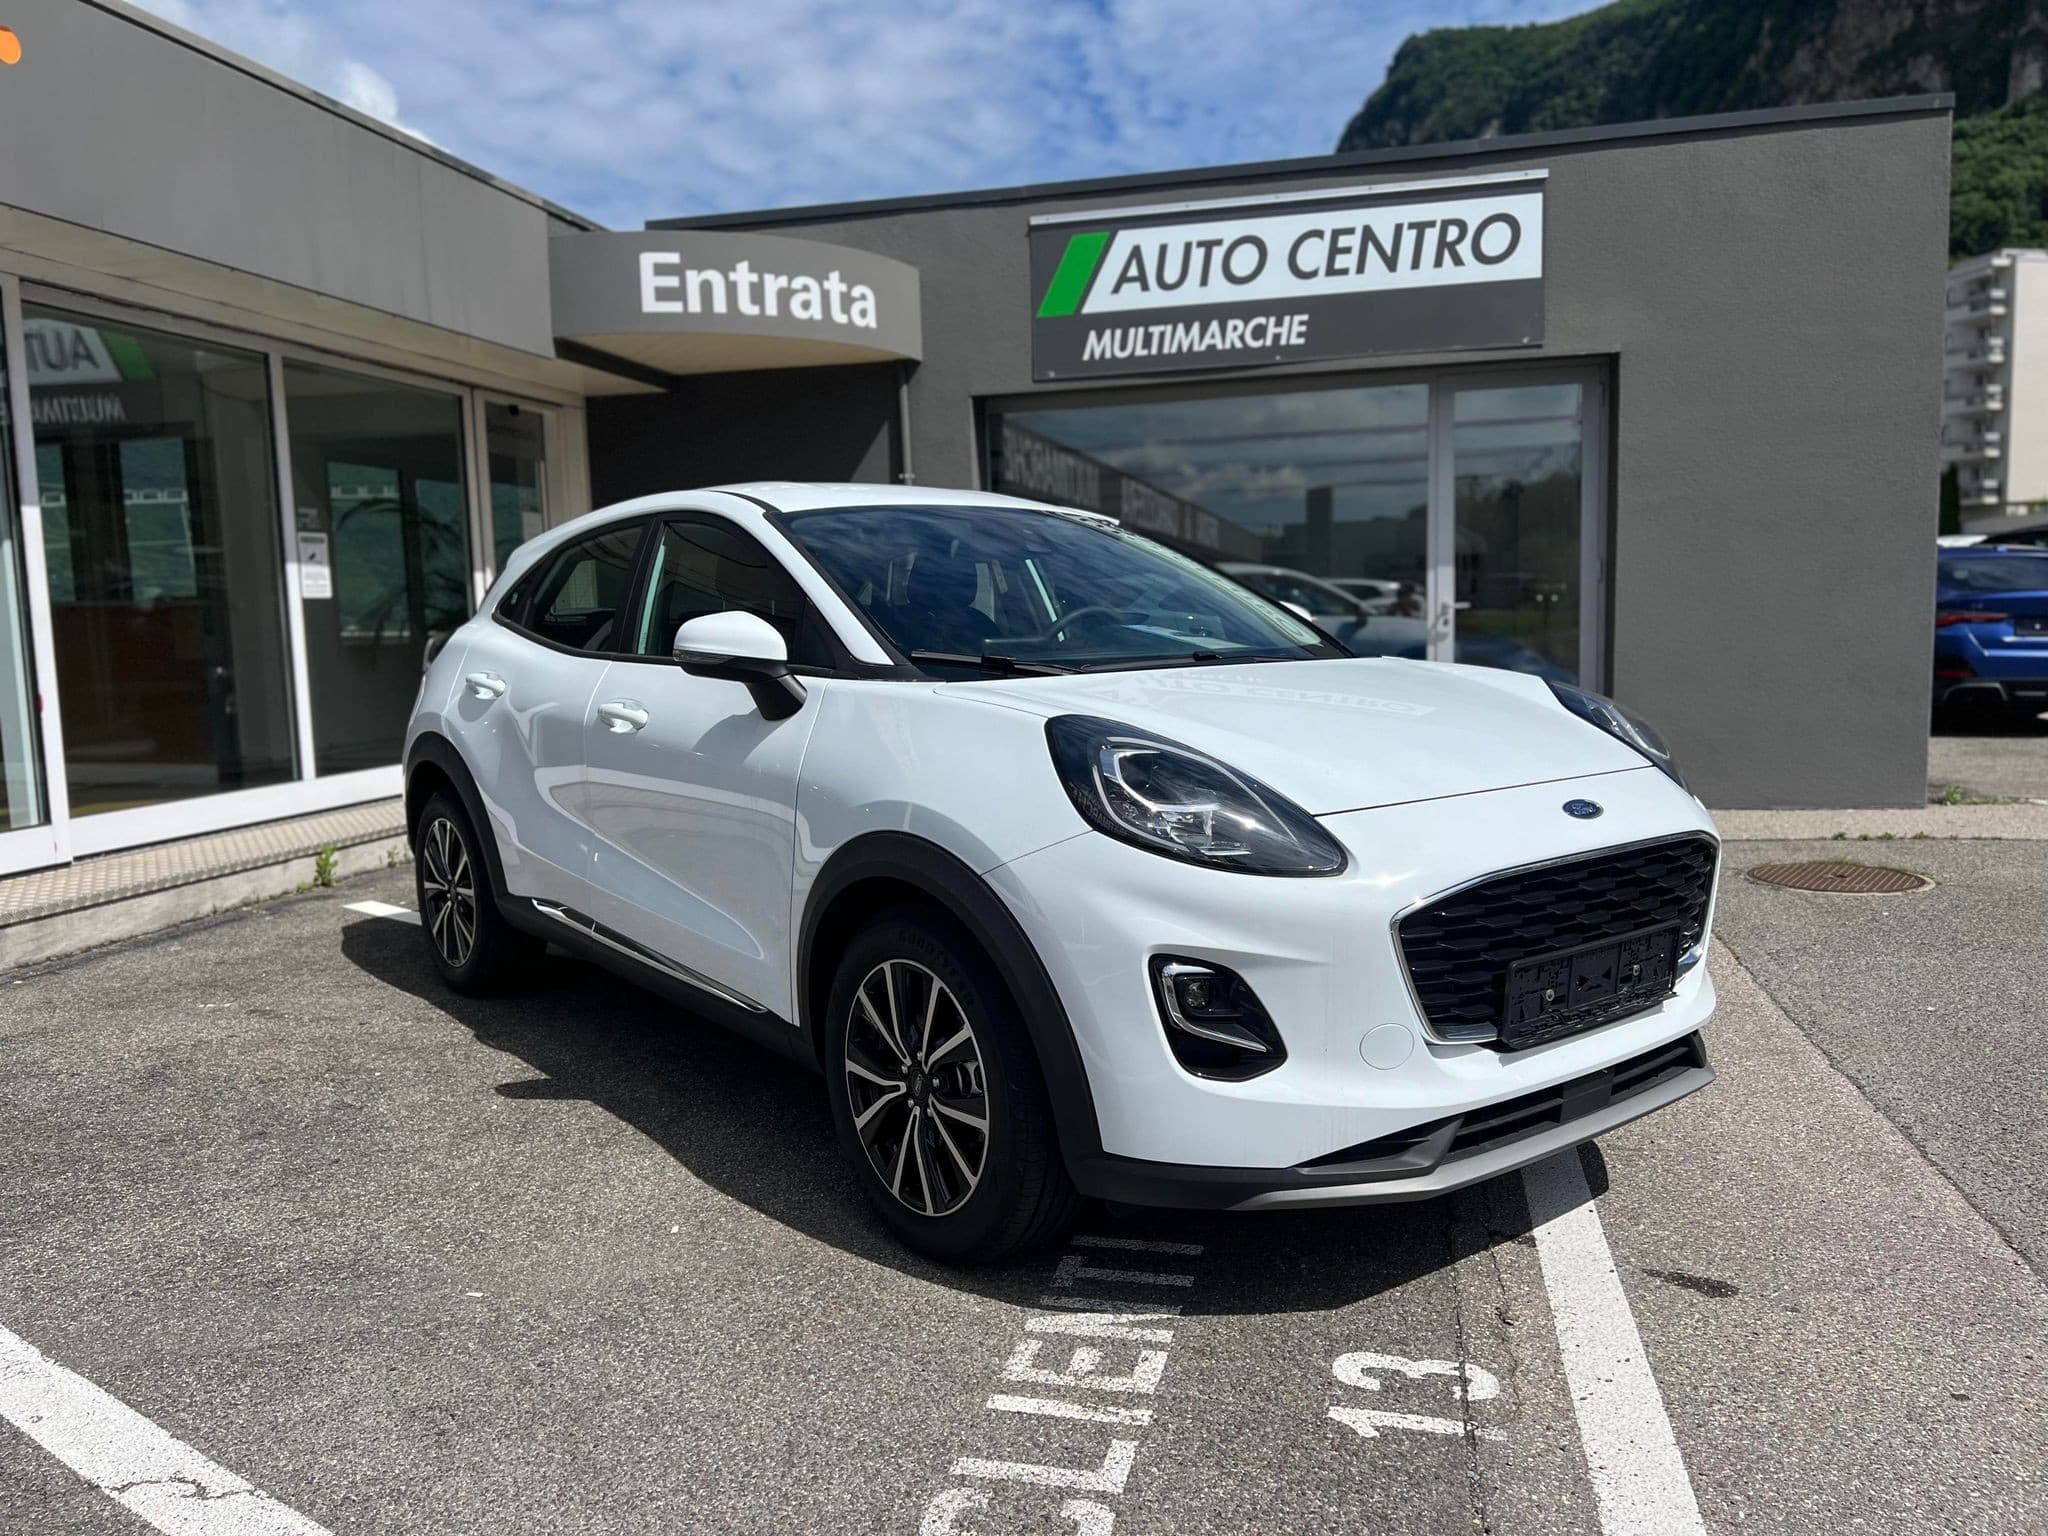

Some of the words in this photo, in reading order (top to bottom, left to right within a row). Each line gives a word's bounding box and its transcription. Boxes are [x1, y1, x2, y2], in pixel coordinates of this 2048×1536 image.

[639, 252, 877, 328] Entrata
[1111, 235, 1267, 295] AUTO
[1288, 212, 1521, 280] CENTRO
[1082, 315, 1309, 361] MULTIMARCHE
[1328, 1351, 1506, 1442] 13
